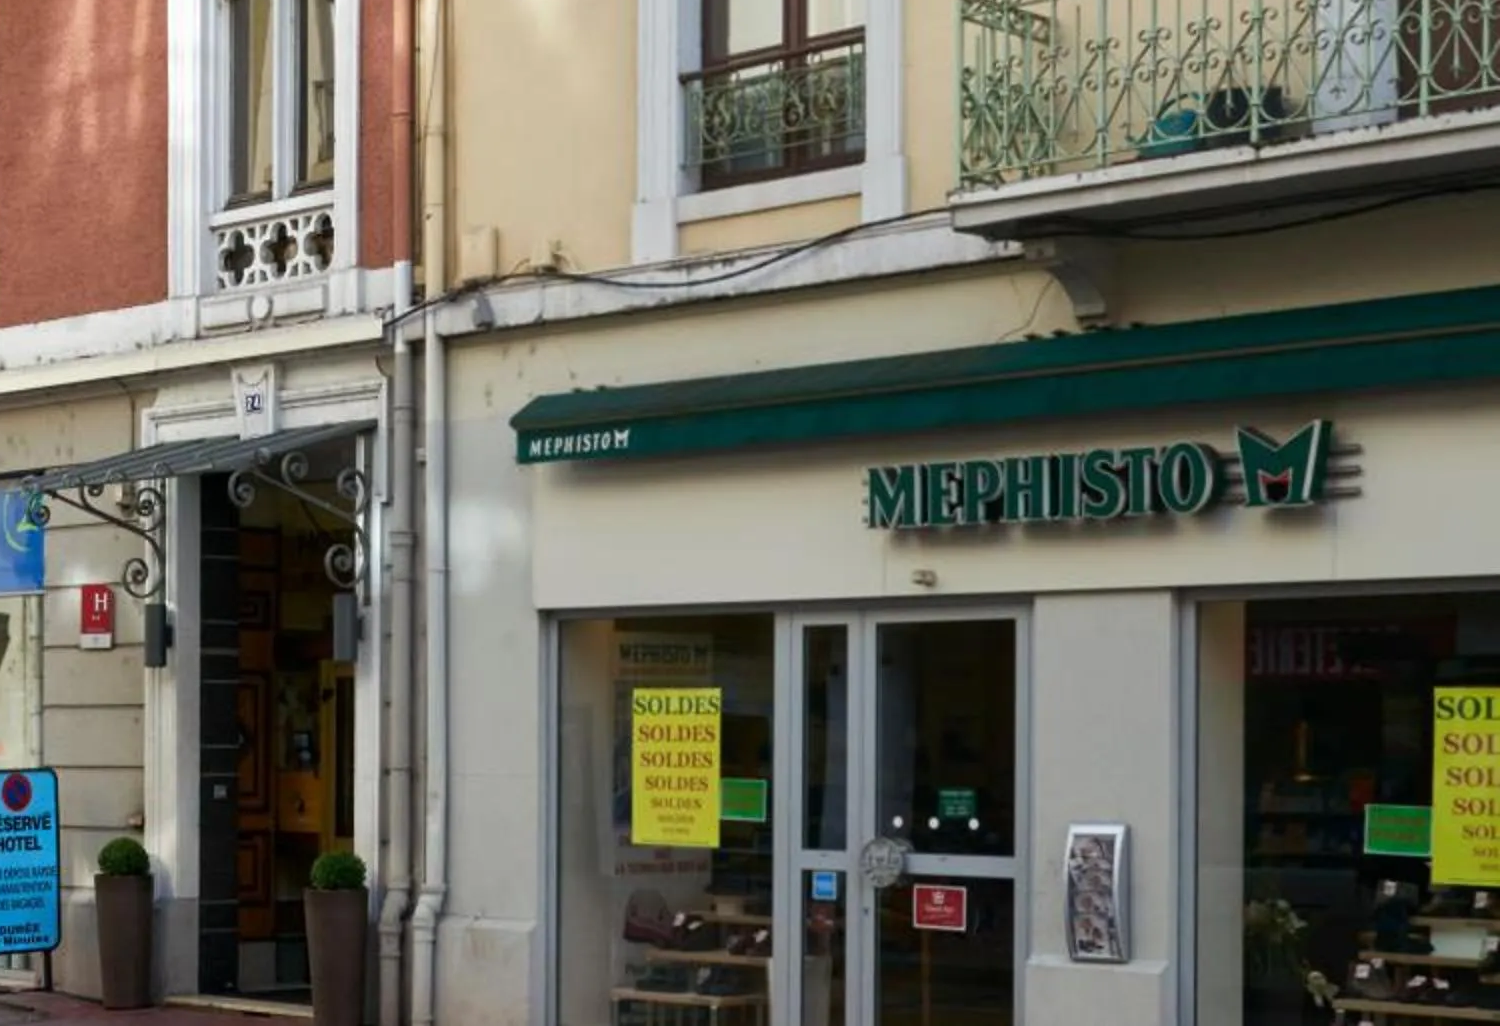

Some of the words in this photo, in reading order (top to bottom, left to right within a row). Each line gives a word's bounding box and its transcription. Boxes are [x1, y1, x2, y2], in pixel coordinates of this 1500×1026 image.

[529, 431, 611, 457] MEPHISTO
[867, 440, 1216, 530] MEPHISTO
[95, 592, 108, 612] H
[633, 695, 720, 716] SOLDES
[638, 723, 716, 743] SOLDES
[639, 751, 713, 769] SOLDES
[645, 775, 709, 793] SOLDES
[651, 796, 704, 810] SOLDES
